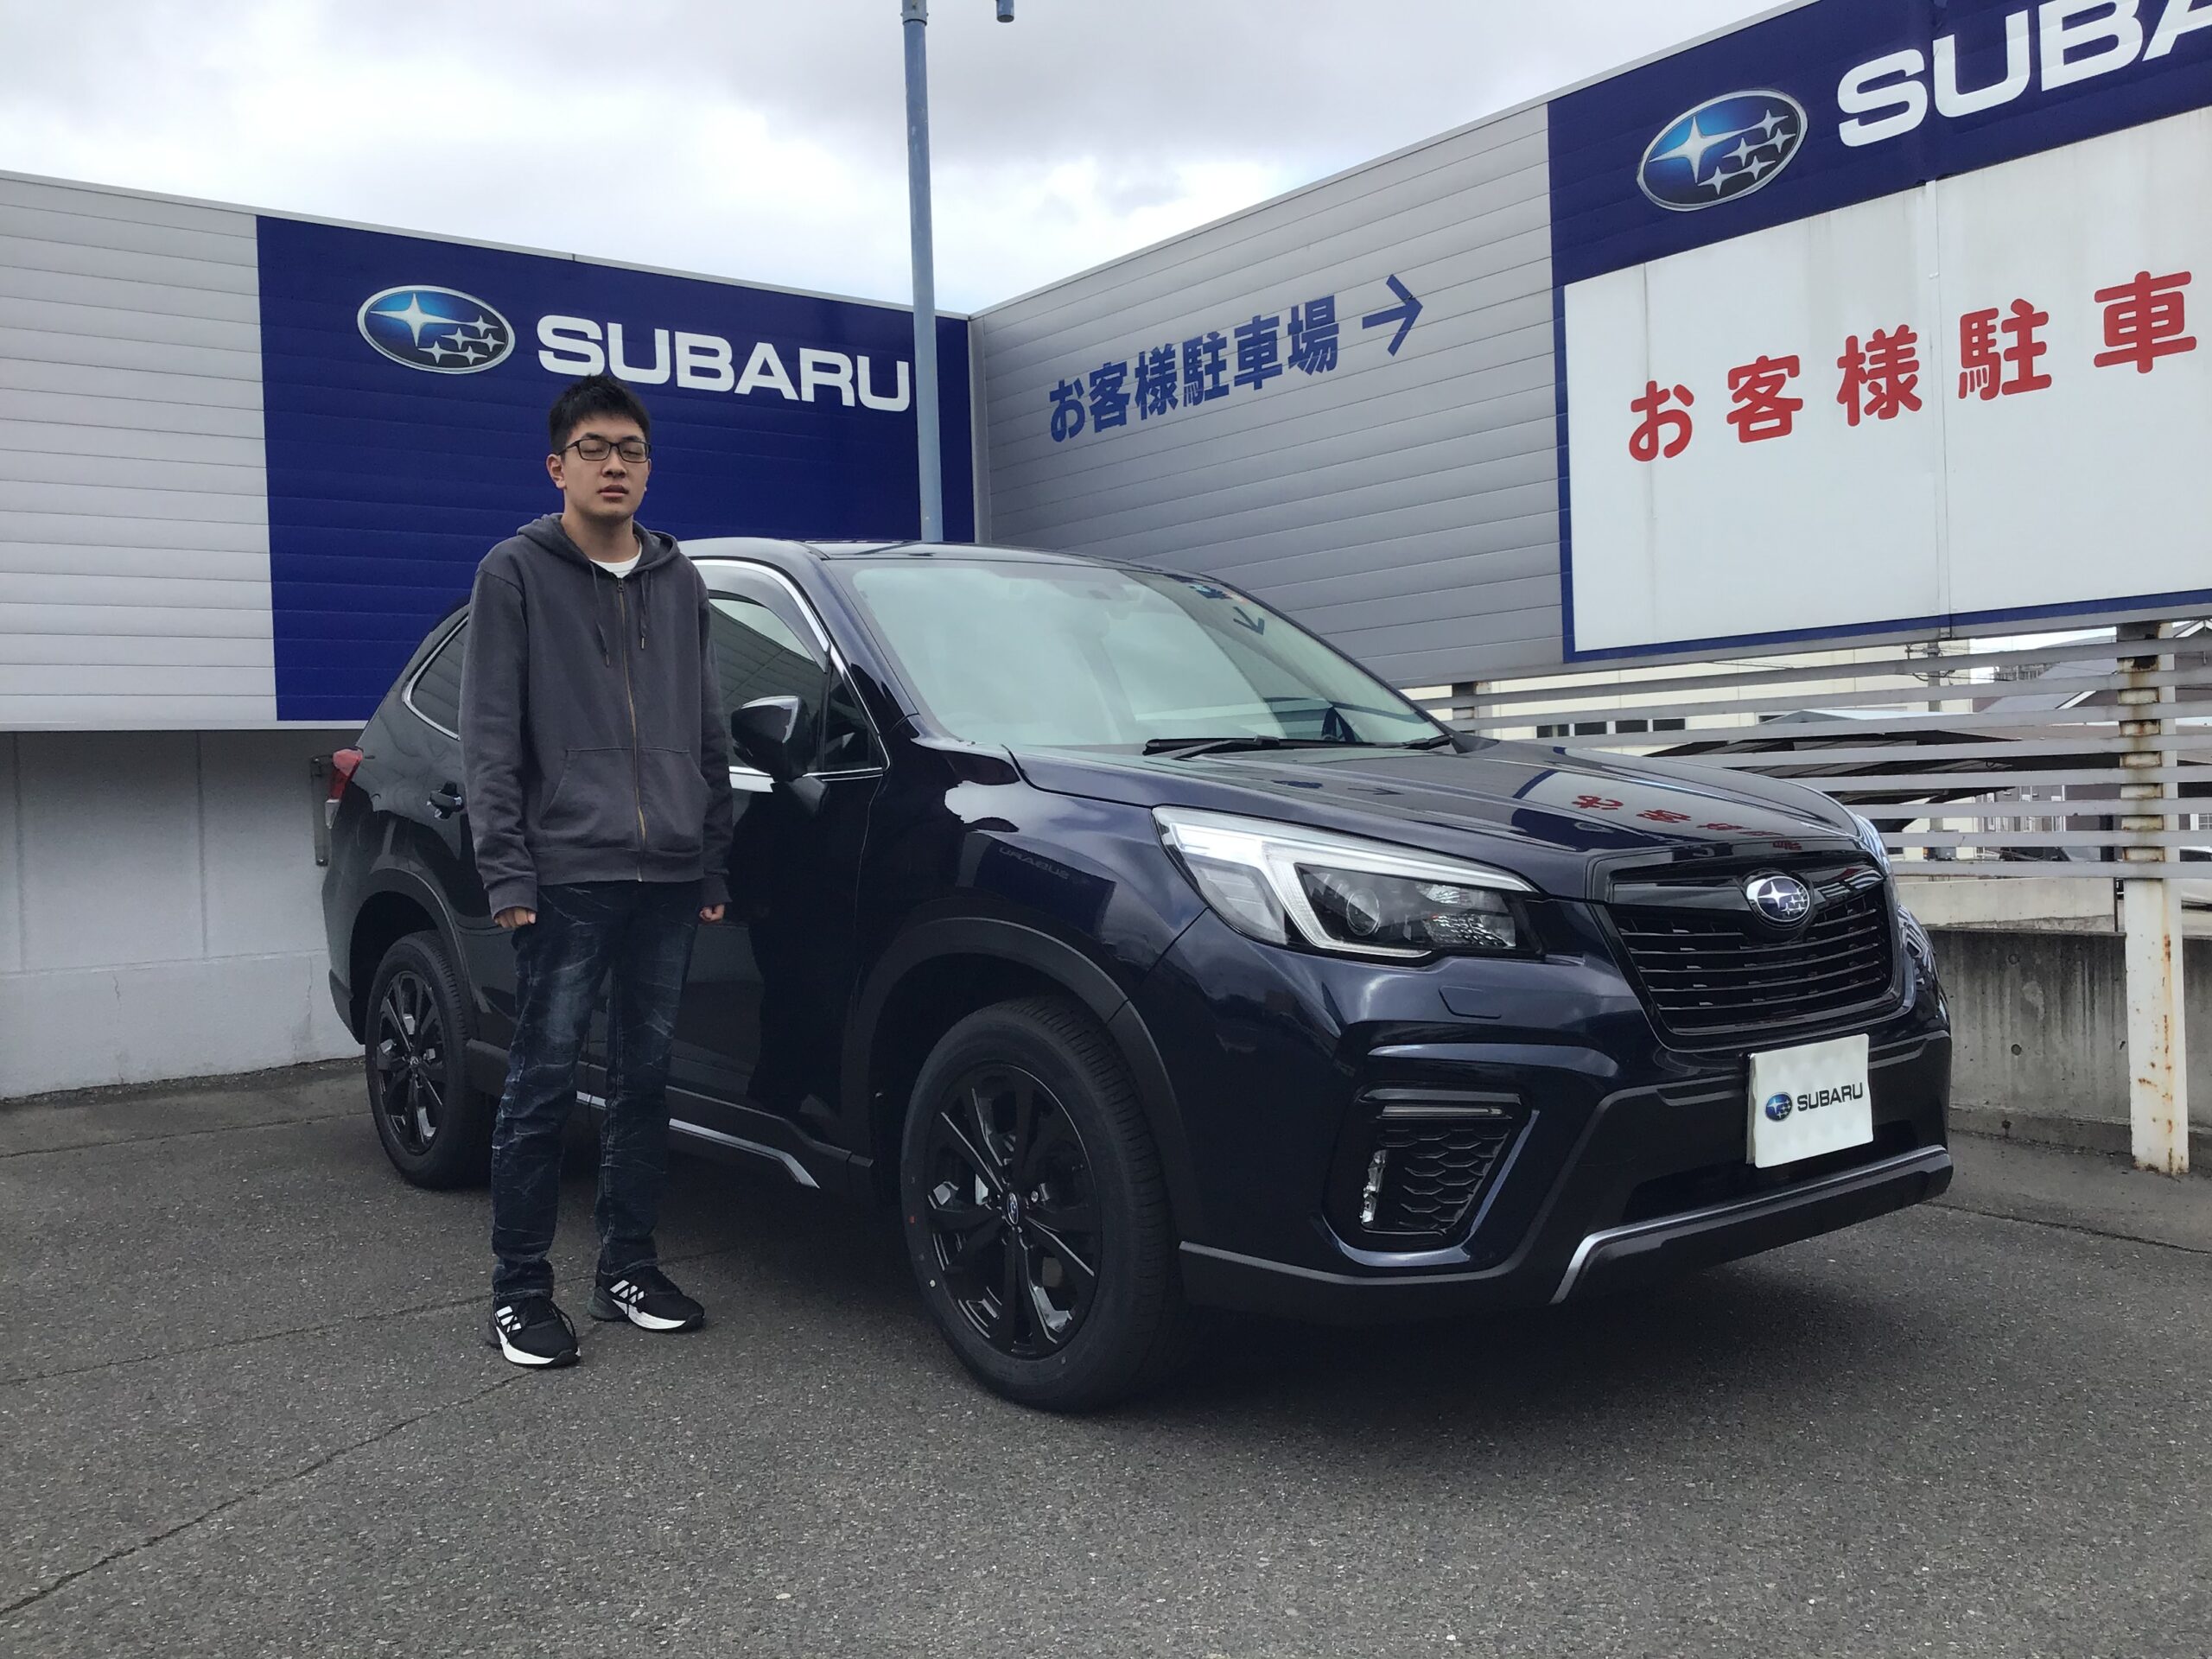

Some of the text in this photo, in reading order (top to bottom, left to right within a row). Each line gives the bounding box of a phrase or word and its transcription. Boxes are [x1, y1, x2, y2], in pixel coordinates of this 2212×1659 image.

[537, 314, 911, 412] SUBARU
[1048, 294, 1340, 443] お客様駐車場
[1629, 271, 2197, 462] お客様駐車
[1797, 1082, 1863, 1112] SUBARU
